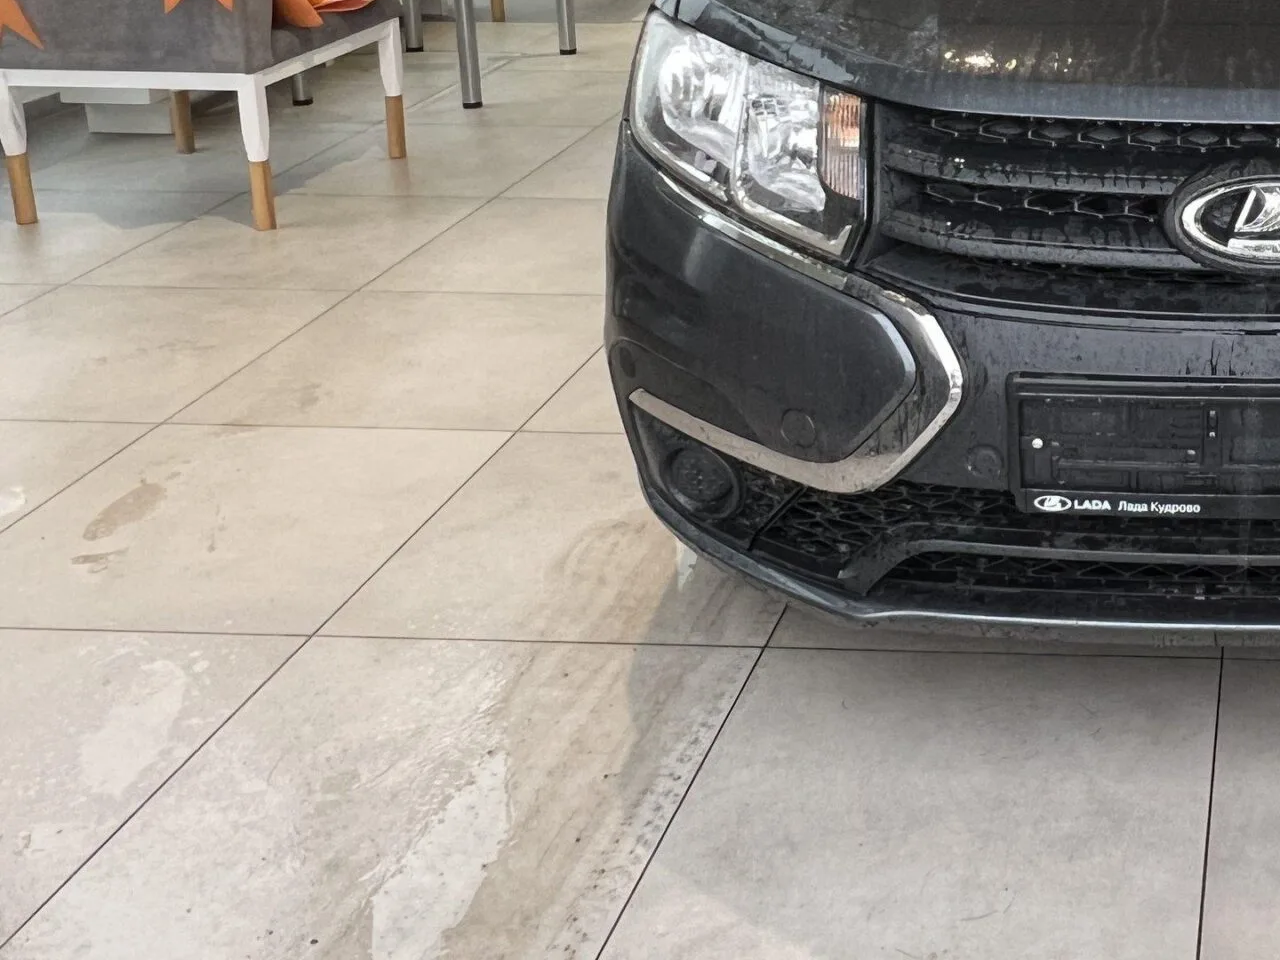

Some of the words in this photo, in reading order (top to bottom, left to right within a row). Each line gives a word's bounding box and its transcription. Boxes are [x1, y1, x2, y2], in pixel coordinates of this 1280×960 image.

[1073, 499, 1112, 511] LADA
[1118, 500, 1149, 513] Лада
[1150, 501, 1201, 515] Кудрово
